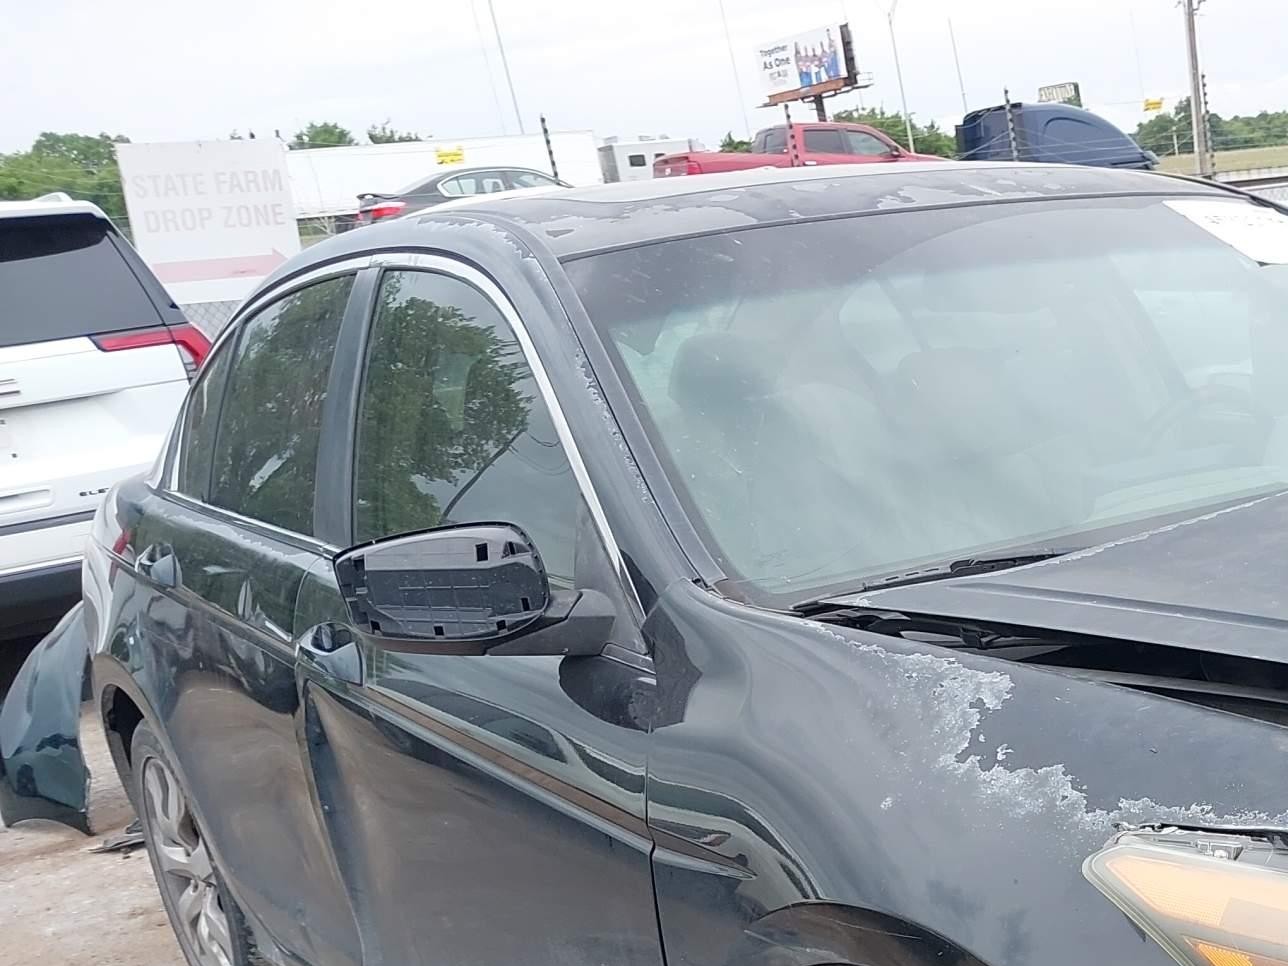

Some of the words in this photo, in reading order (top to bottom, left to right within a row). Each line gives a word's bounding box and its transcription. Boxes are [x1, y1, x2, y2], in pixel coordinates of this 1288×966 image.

[763, 61, 774, 71] As
[775, 57, 790, 67] One
[131, 173, 208, 199] STATE
[214, 169, 284, 195] FARM
[143, 207, 214, 233] DROP
[221, 203, 286, 228] ZONE
